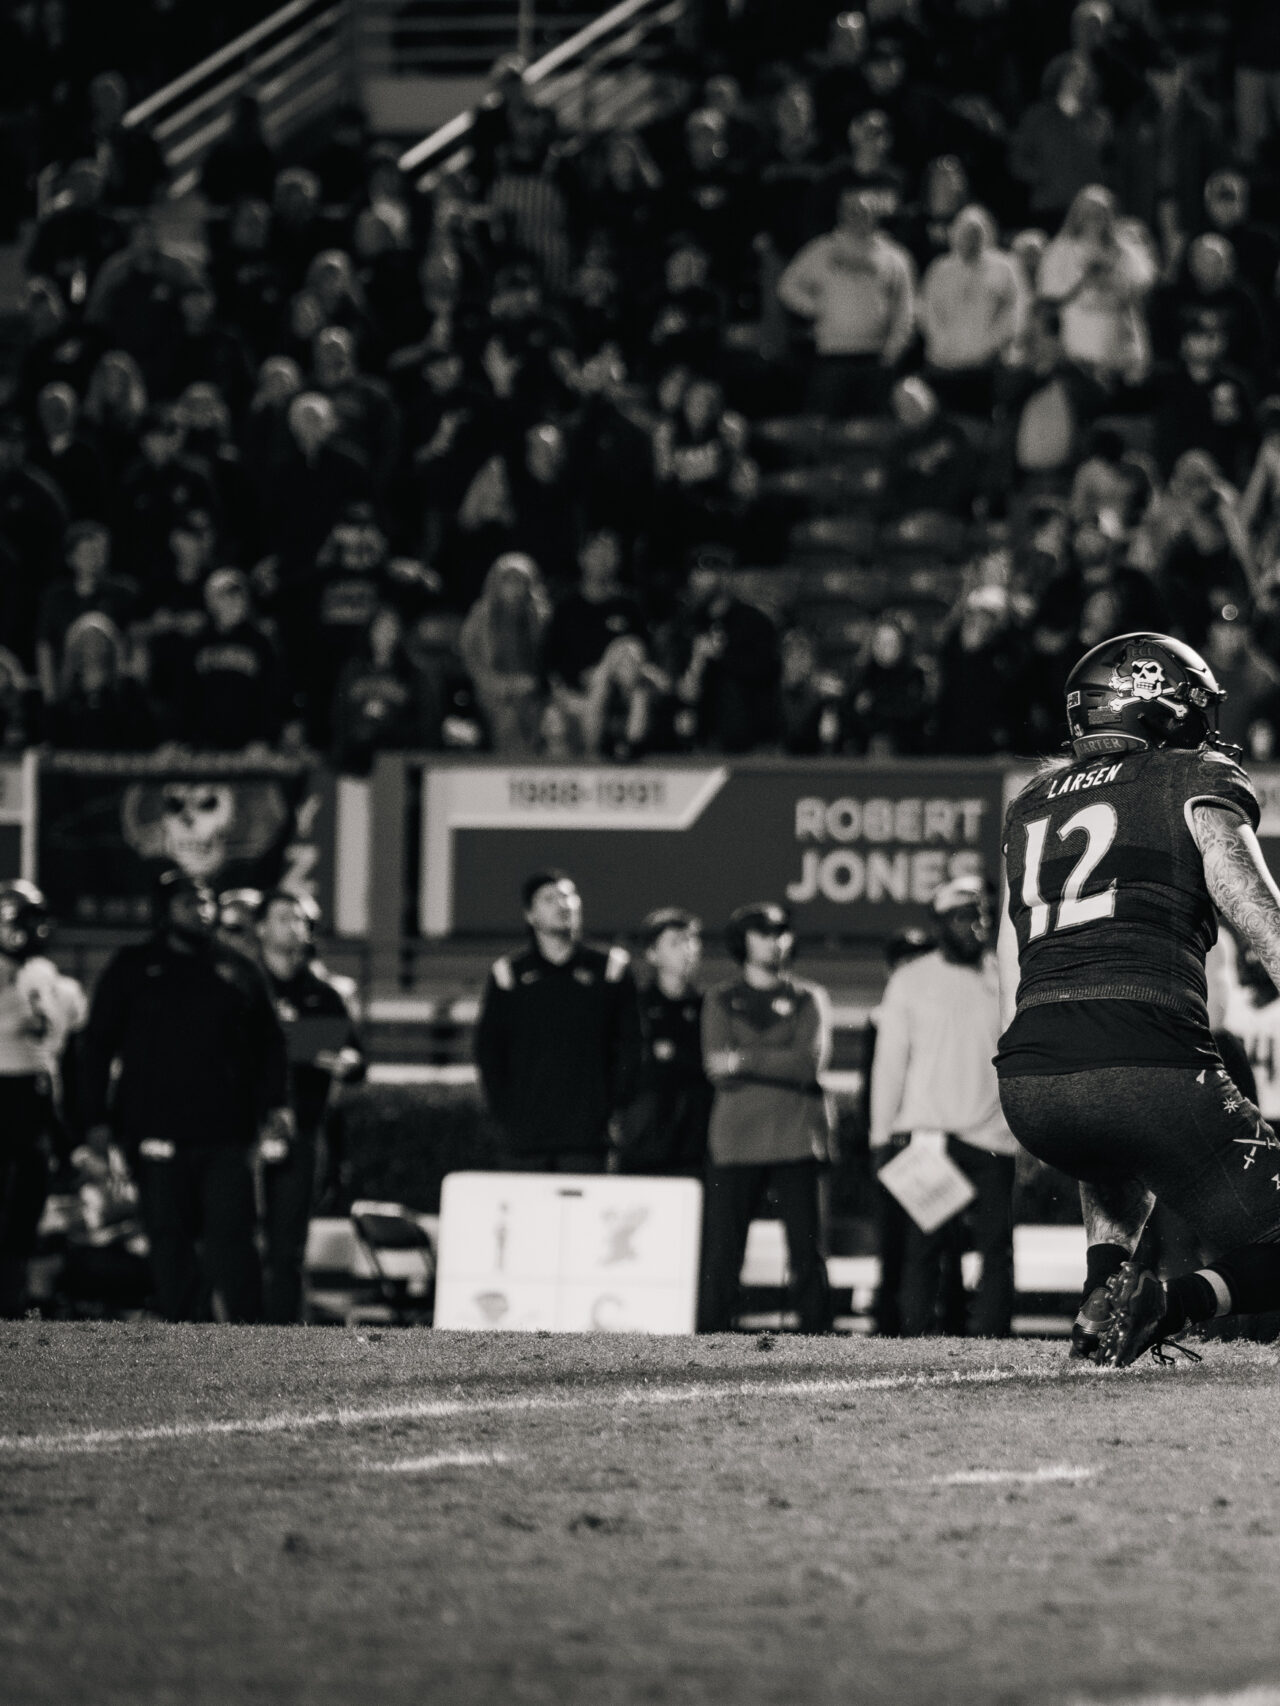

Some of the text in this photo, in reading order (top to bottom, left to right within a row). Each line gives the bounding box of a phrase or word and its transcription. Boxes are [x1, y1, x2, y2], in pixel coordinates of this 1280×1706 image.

[1047, 763, 1123, 799] LARSEN
[794, 798, 984, 842] ROBERT
[1021, 801, 1118, 942] 12
